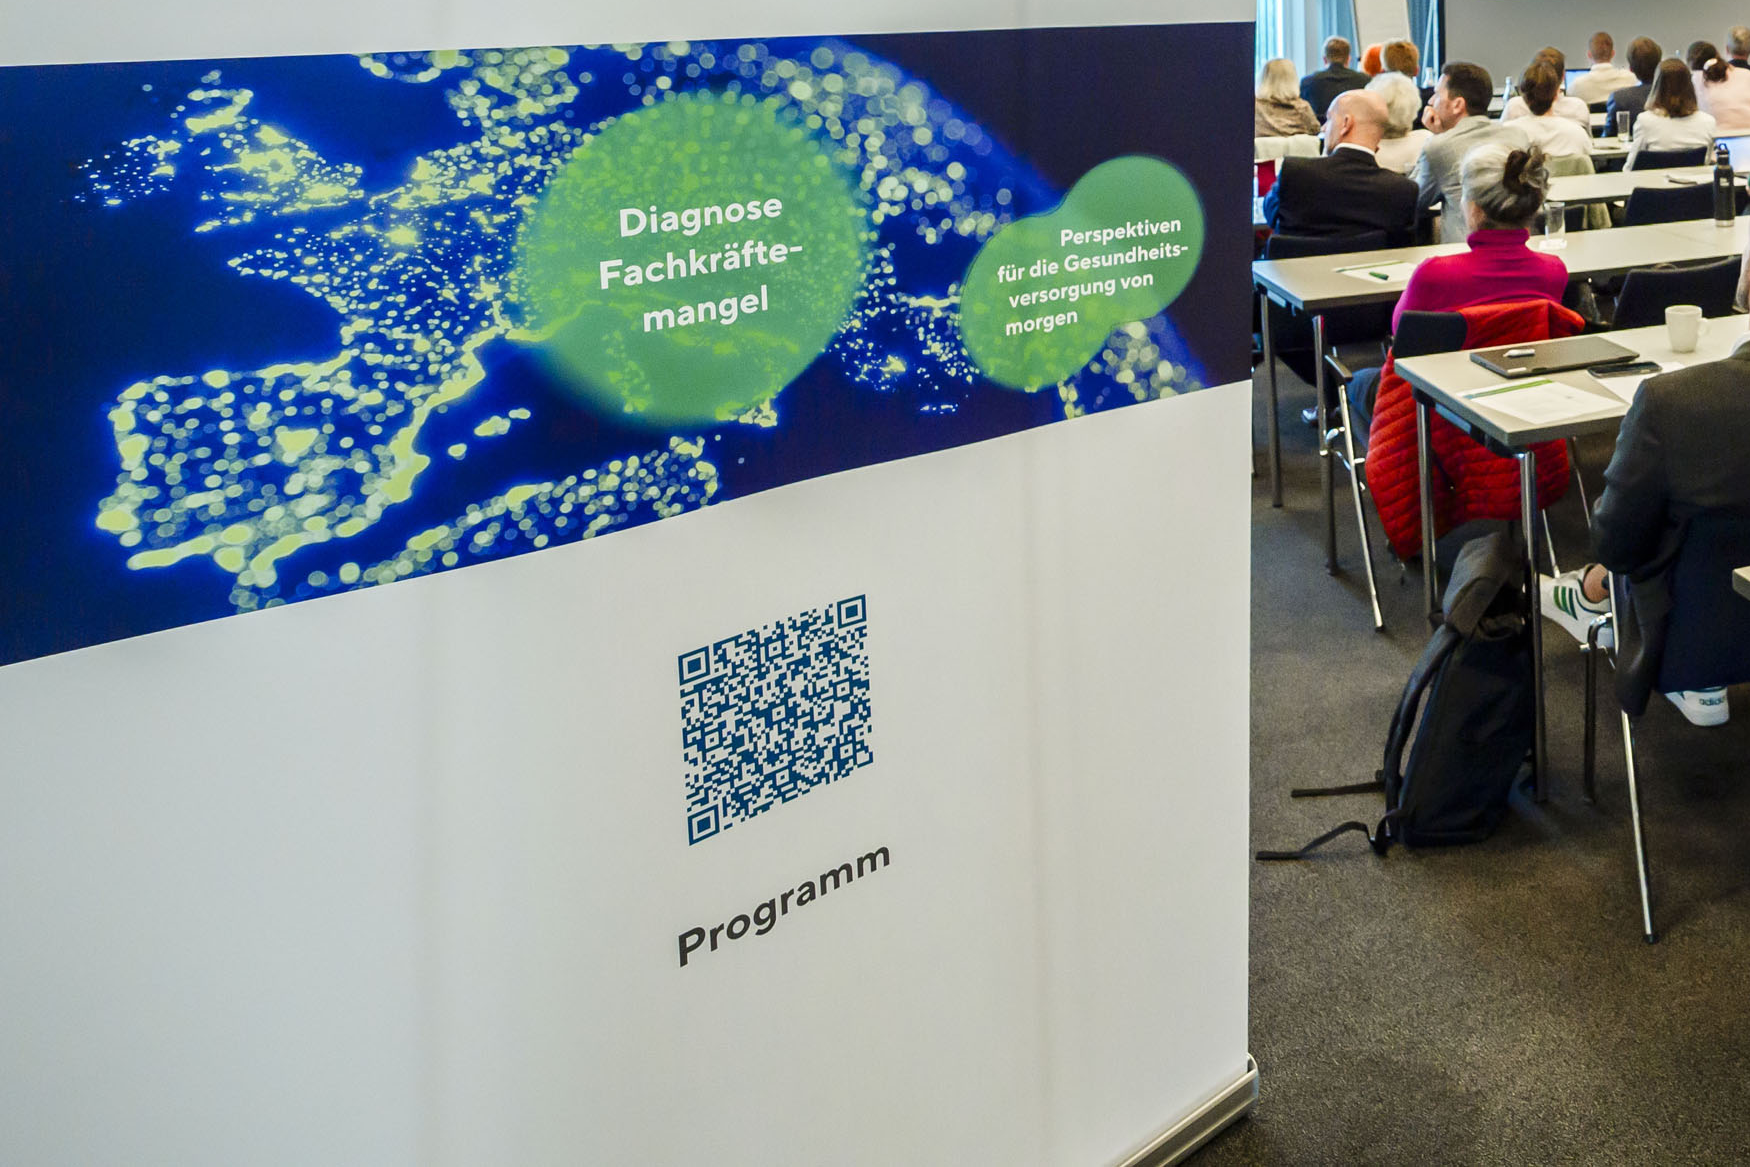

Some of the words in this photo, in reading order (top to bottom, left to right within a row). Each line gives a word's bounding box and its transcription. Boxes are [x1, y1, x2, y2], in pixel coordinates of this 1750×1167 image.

[619, 198, 783, 238] Diagnose
[1060, 219, 1182, 247] Perspektiven
[600, 239, 803, 290] Fachkräfte-
[997, 266, 1025, 283] für
[1029, 259, 1059, 278] die
[1064, 242, 1189, 272] Gesundheits-
[643, 284, 769, 333] mangel
[1008, 277, 1116, 308] versorgung
[1120, 273, 1154, 290] von
[1005, 311, 1079, 336] morgen
[678, 846, 890, 967] Programm
